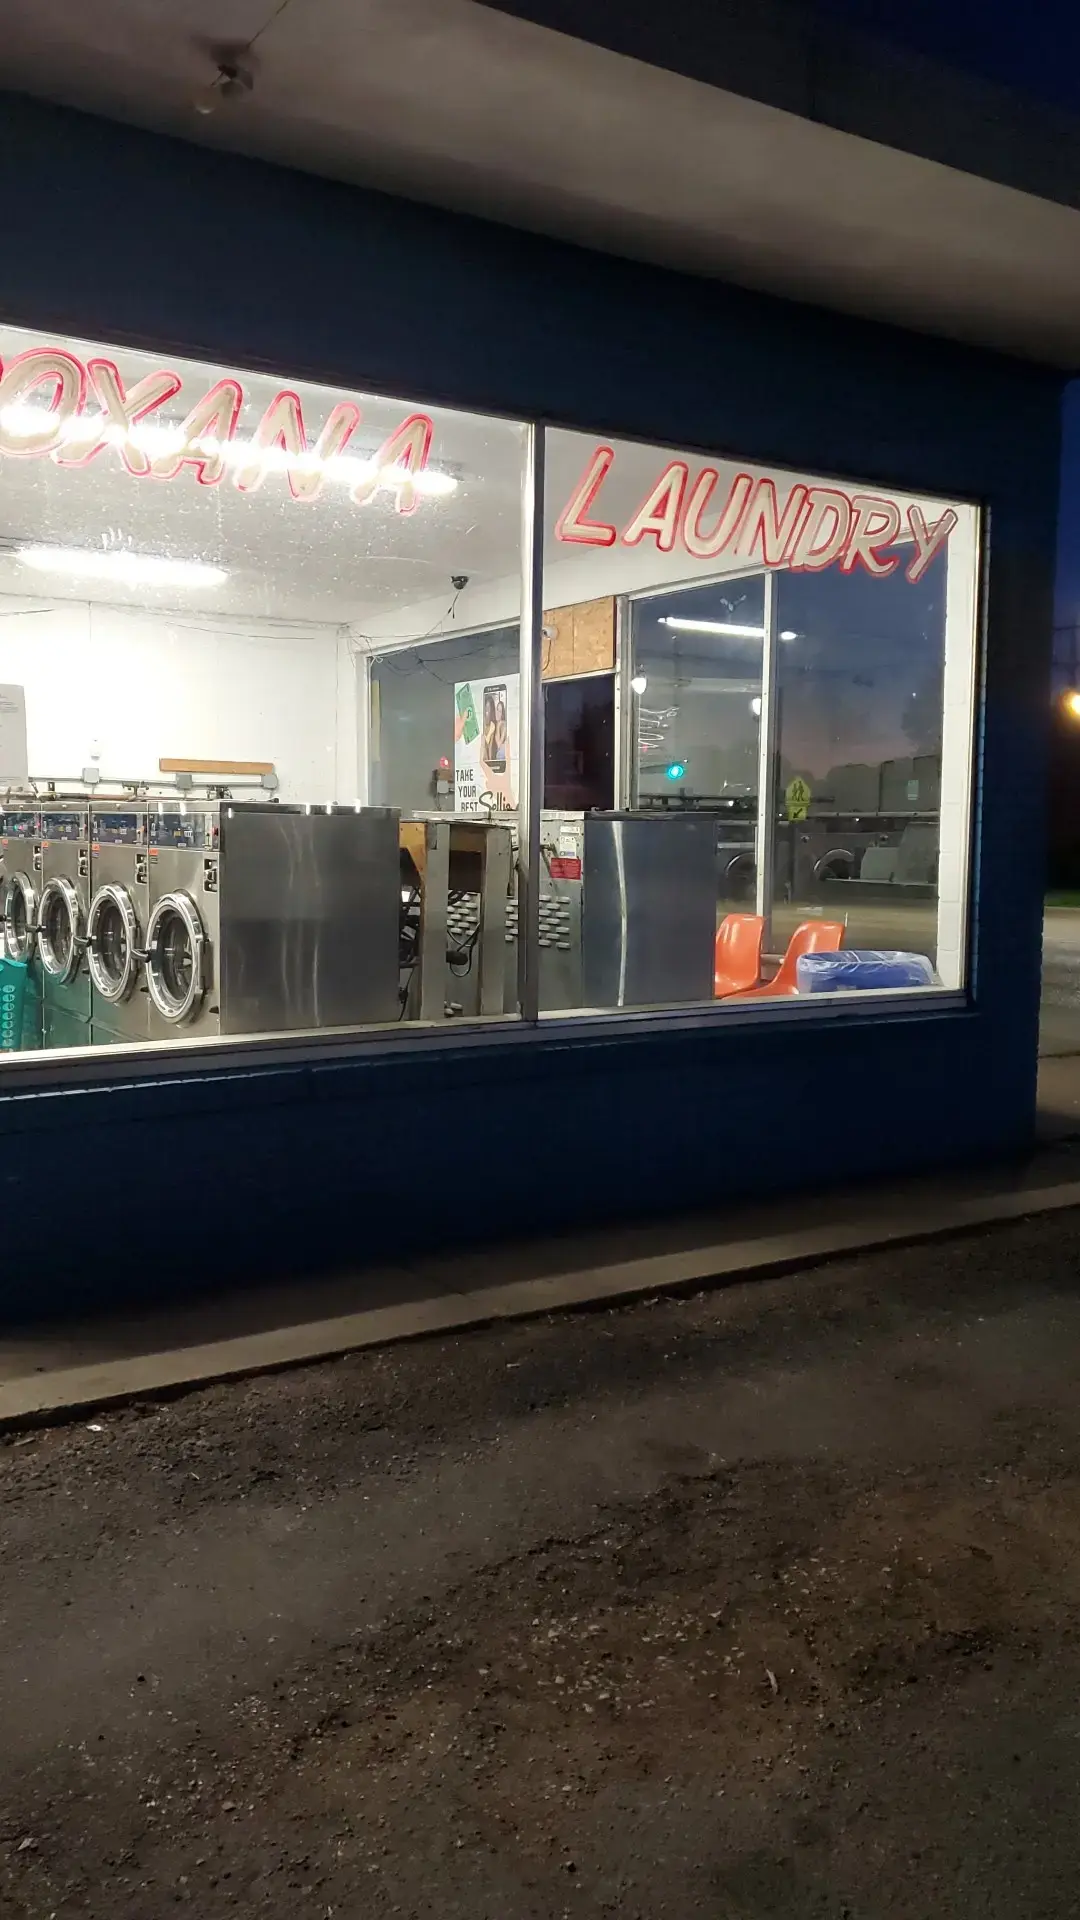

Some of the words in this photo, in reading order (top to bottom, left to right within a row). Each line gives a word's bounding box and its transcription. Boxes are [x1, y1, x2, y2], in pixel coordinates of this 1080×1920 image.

[0, 346, 434, 516] OXANA
[555, 445, 958, 584] LAUNDRY
[455, 769, 474, 782] TAKE
[458, 785, 477, 798] YOUR
[461, 801, 479, 812] BEST
